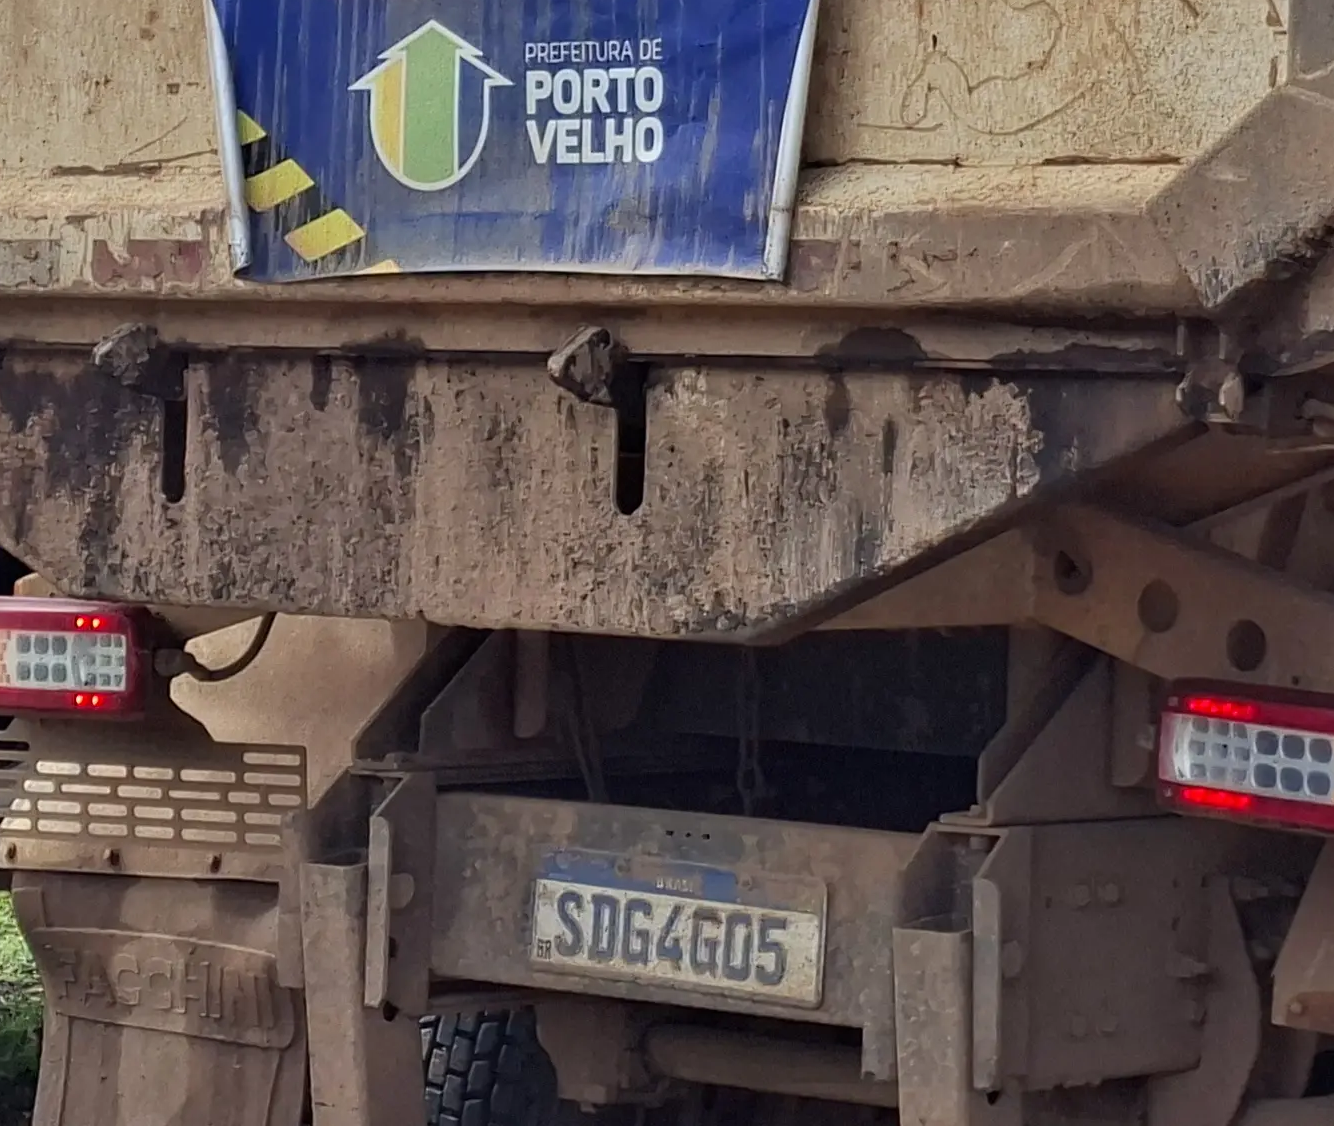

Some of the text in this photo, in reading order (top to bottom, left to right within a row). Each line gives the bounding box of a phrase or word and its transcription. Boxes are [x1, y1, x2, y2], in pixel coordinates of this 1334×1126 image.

[525, 38, 662, 64] PREFEITURA DE
[526, 66, 664, 115] PORTO
[527, 117, 664, 164] VELHO
